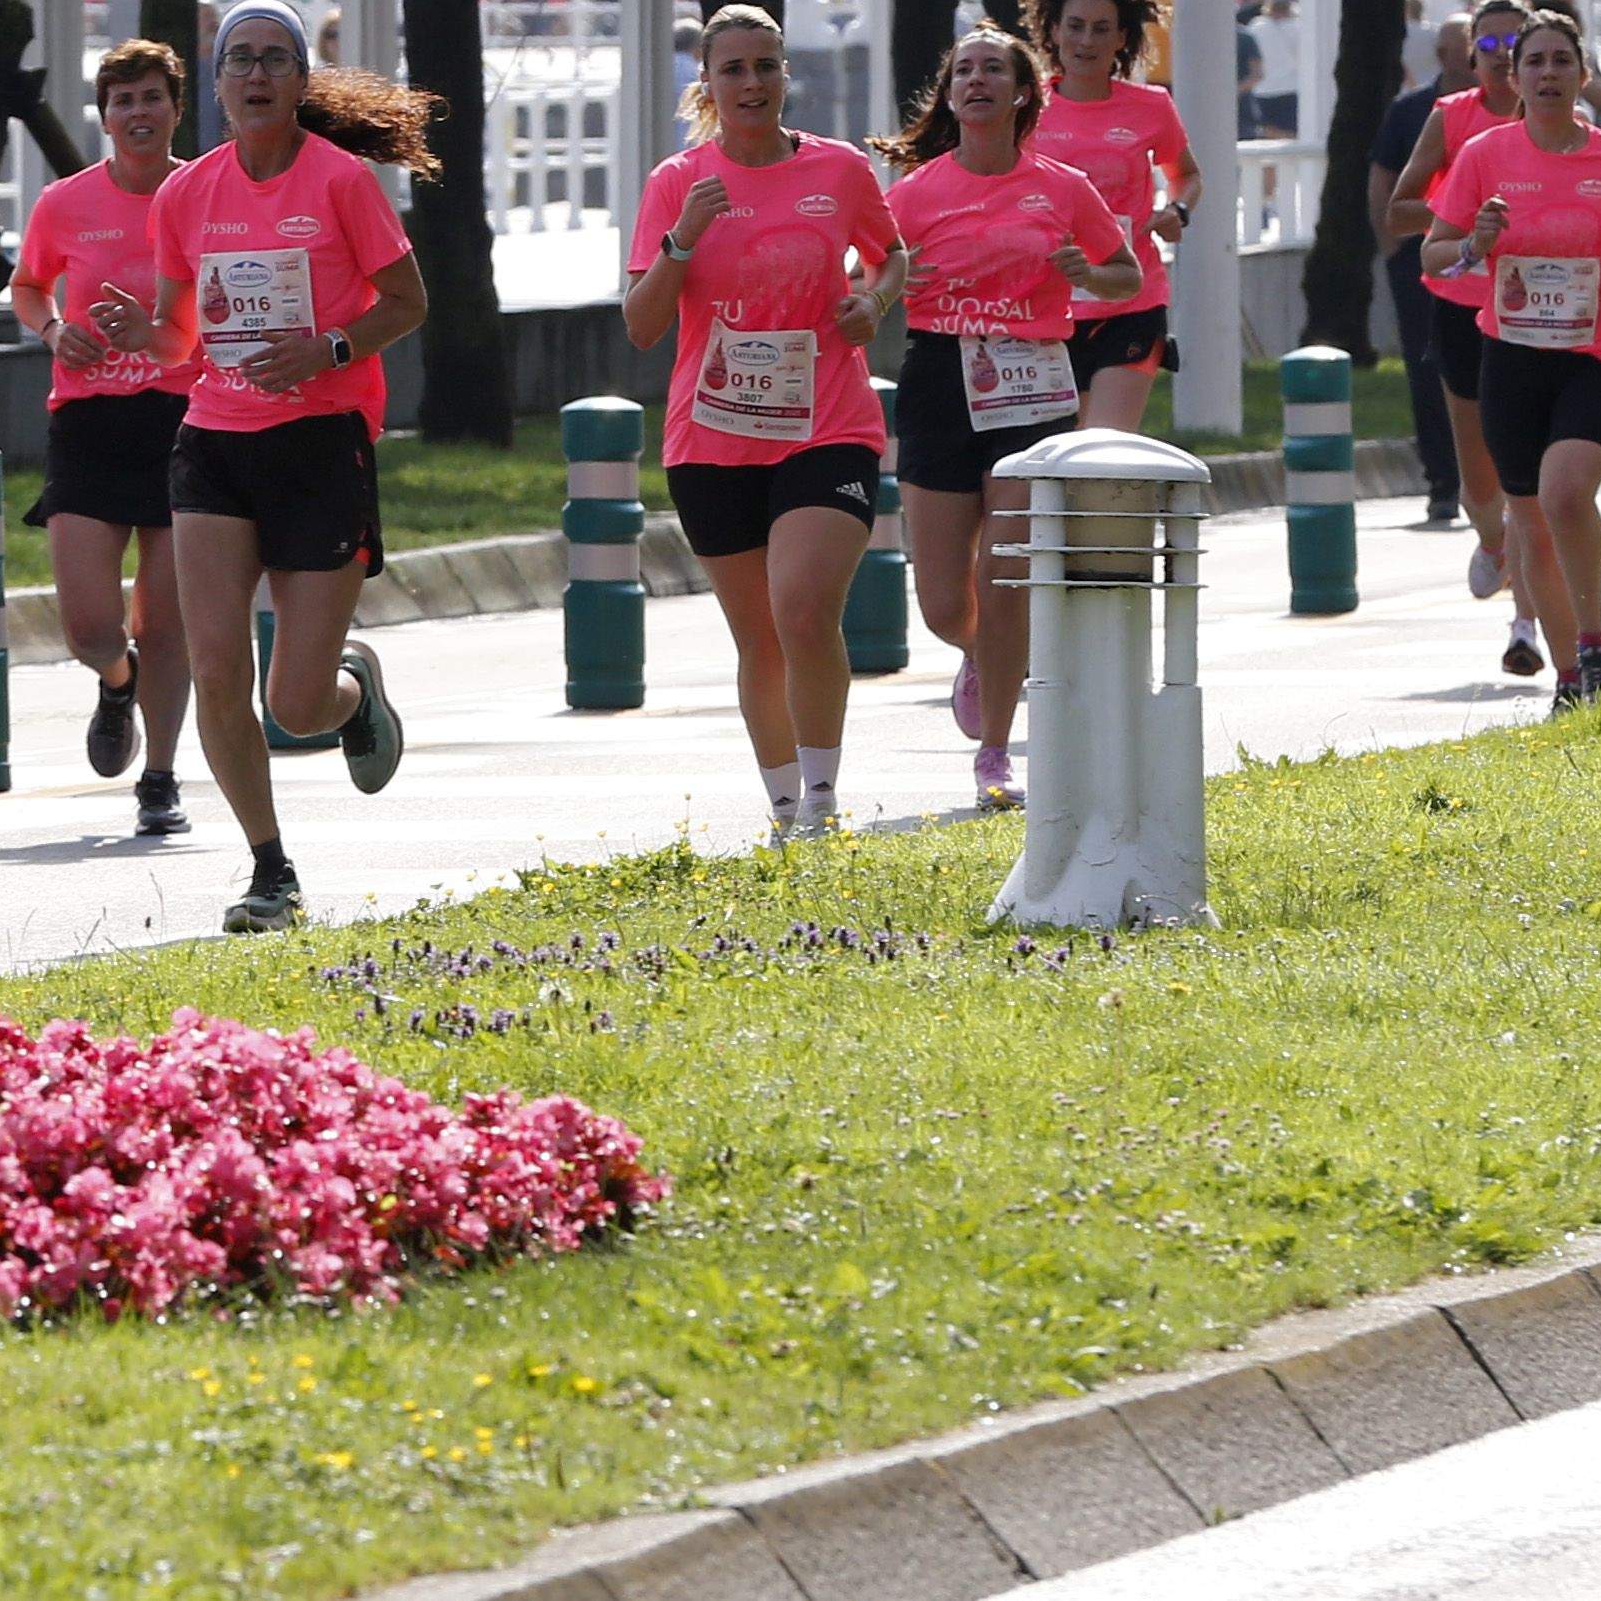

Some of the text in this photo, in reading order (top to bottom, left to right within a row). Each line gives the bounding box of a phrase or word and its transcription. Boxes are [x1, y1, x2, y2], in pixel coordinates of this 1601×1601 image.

[78, 228, 124, 242] OYSHO
[201, 221, 248, 235] OYSHO
[232, 296, 271, 313] 016
[1530, 291, 1565, 306] 016
[711, 299, 742, 323] TU
[241, 316, 267, 328] 4385
[931, 314, 1009, 335] SUMA
[731, 372, 773, 390] 016
[1001, 366, 1037, 381] 016
[736, 391, 763, 403] 3807
